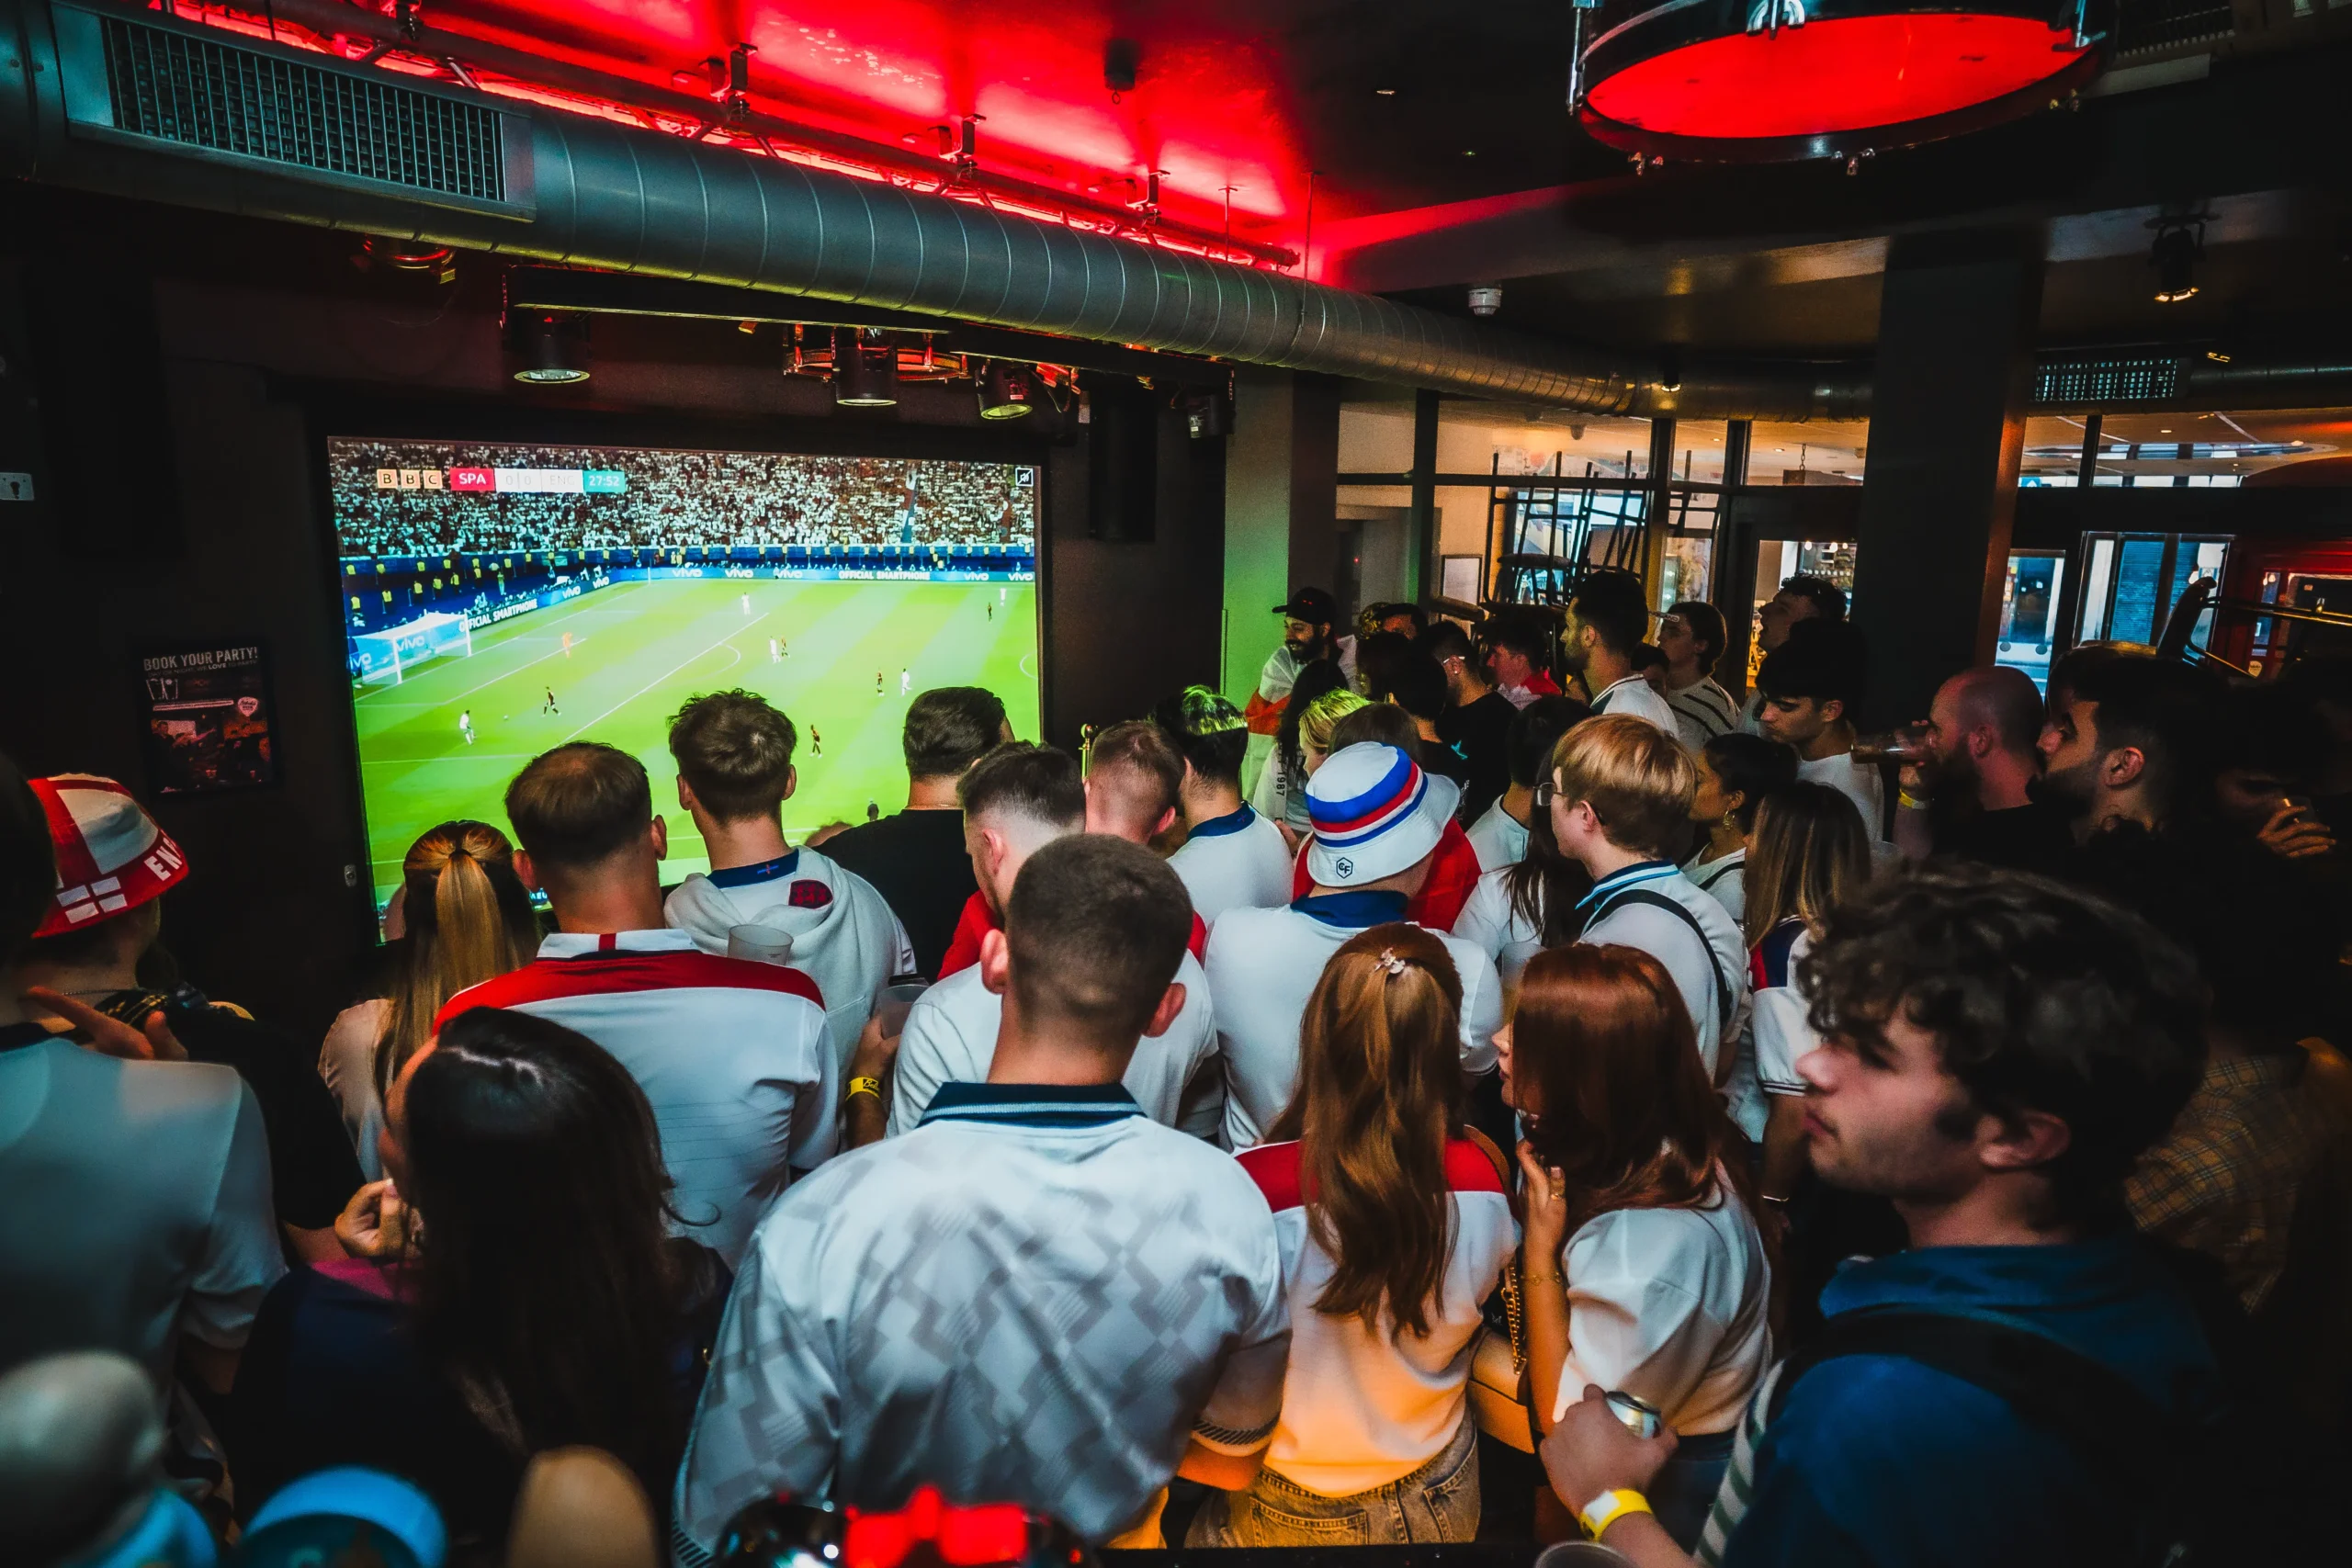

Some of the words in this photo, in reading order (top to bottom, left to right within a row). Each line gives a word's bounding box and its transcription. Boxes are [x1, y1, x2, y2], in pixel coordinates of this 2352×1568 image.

[380, 471, 439, 486] BBC
[458, 472, 487, 484] SPA
[549, 475, 575, 486] ENG
[589, 476, 620, 487] 27:52
[839, 570, 874, 580] OFFICIAL
[876, 570, 930, 581] SMARTPHONE
[458, 613, 492, 632] OFICIAL
[492, 598, 537, 622] SMARTPHONE
[143, 655, 177, 671] BOOK
[180, 650, 213, 667] YOUR
[216, 647, 258, 663] PARTY!
[208, 662, 227, 671] LOVE
[349, 653, 372, 670] ivo
[1276, 772, 1286, 796] 1987
[143, 829, 183, 882] EN
